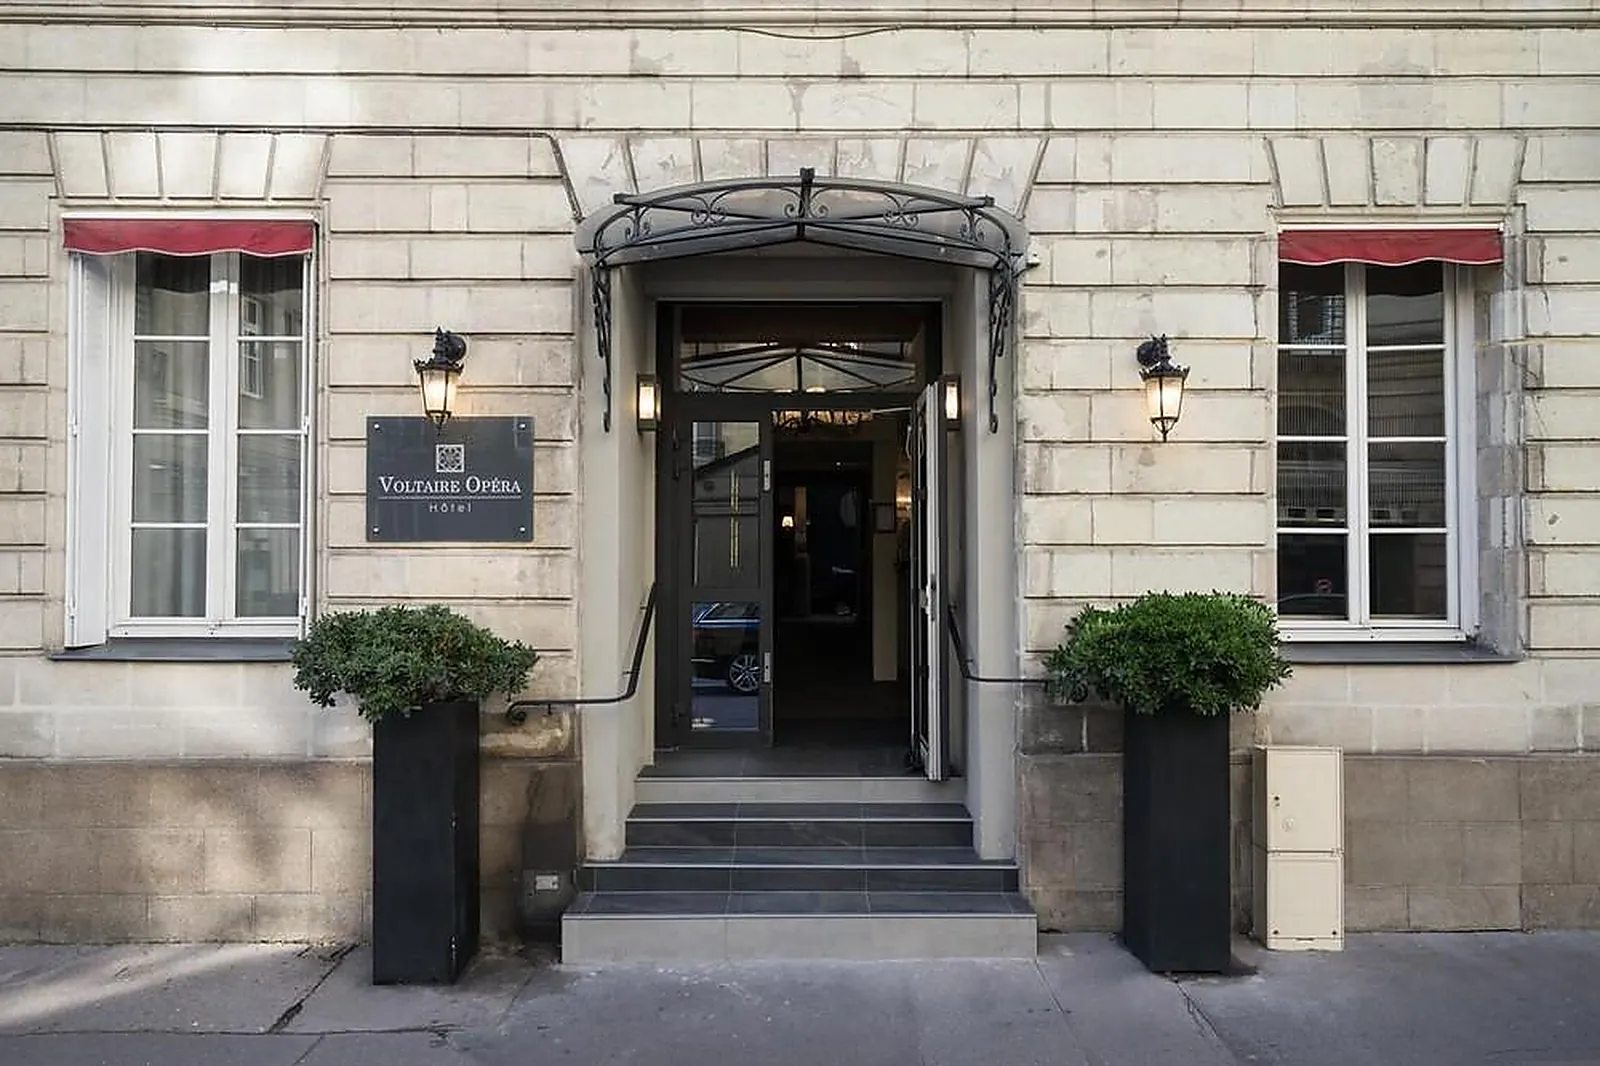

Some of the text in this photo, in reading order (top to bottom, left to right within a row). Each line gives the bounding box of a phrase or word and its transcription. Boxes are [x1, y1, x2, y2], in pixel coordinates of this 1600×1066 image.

[379, 475, 521, 493] VOLTAIRE OPÉRA
[429, 502, 472, 513] Hôtel
